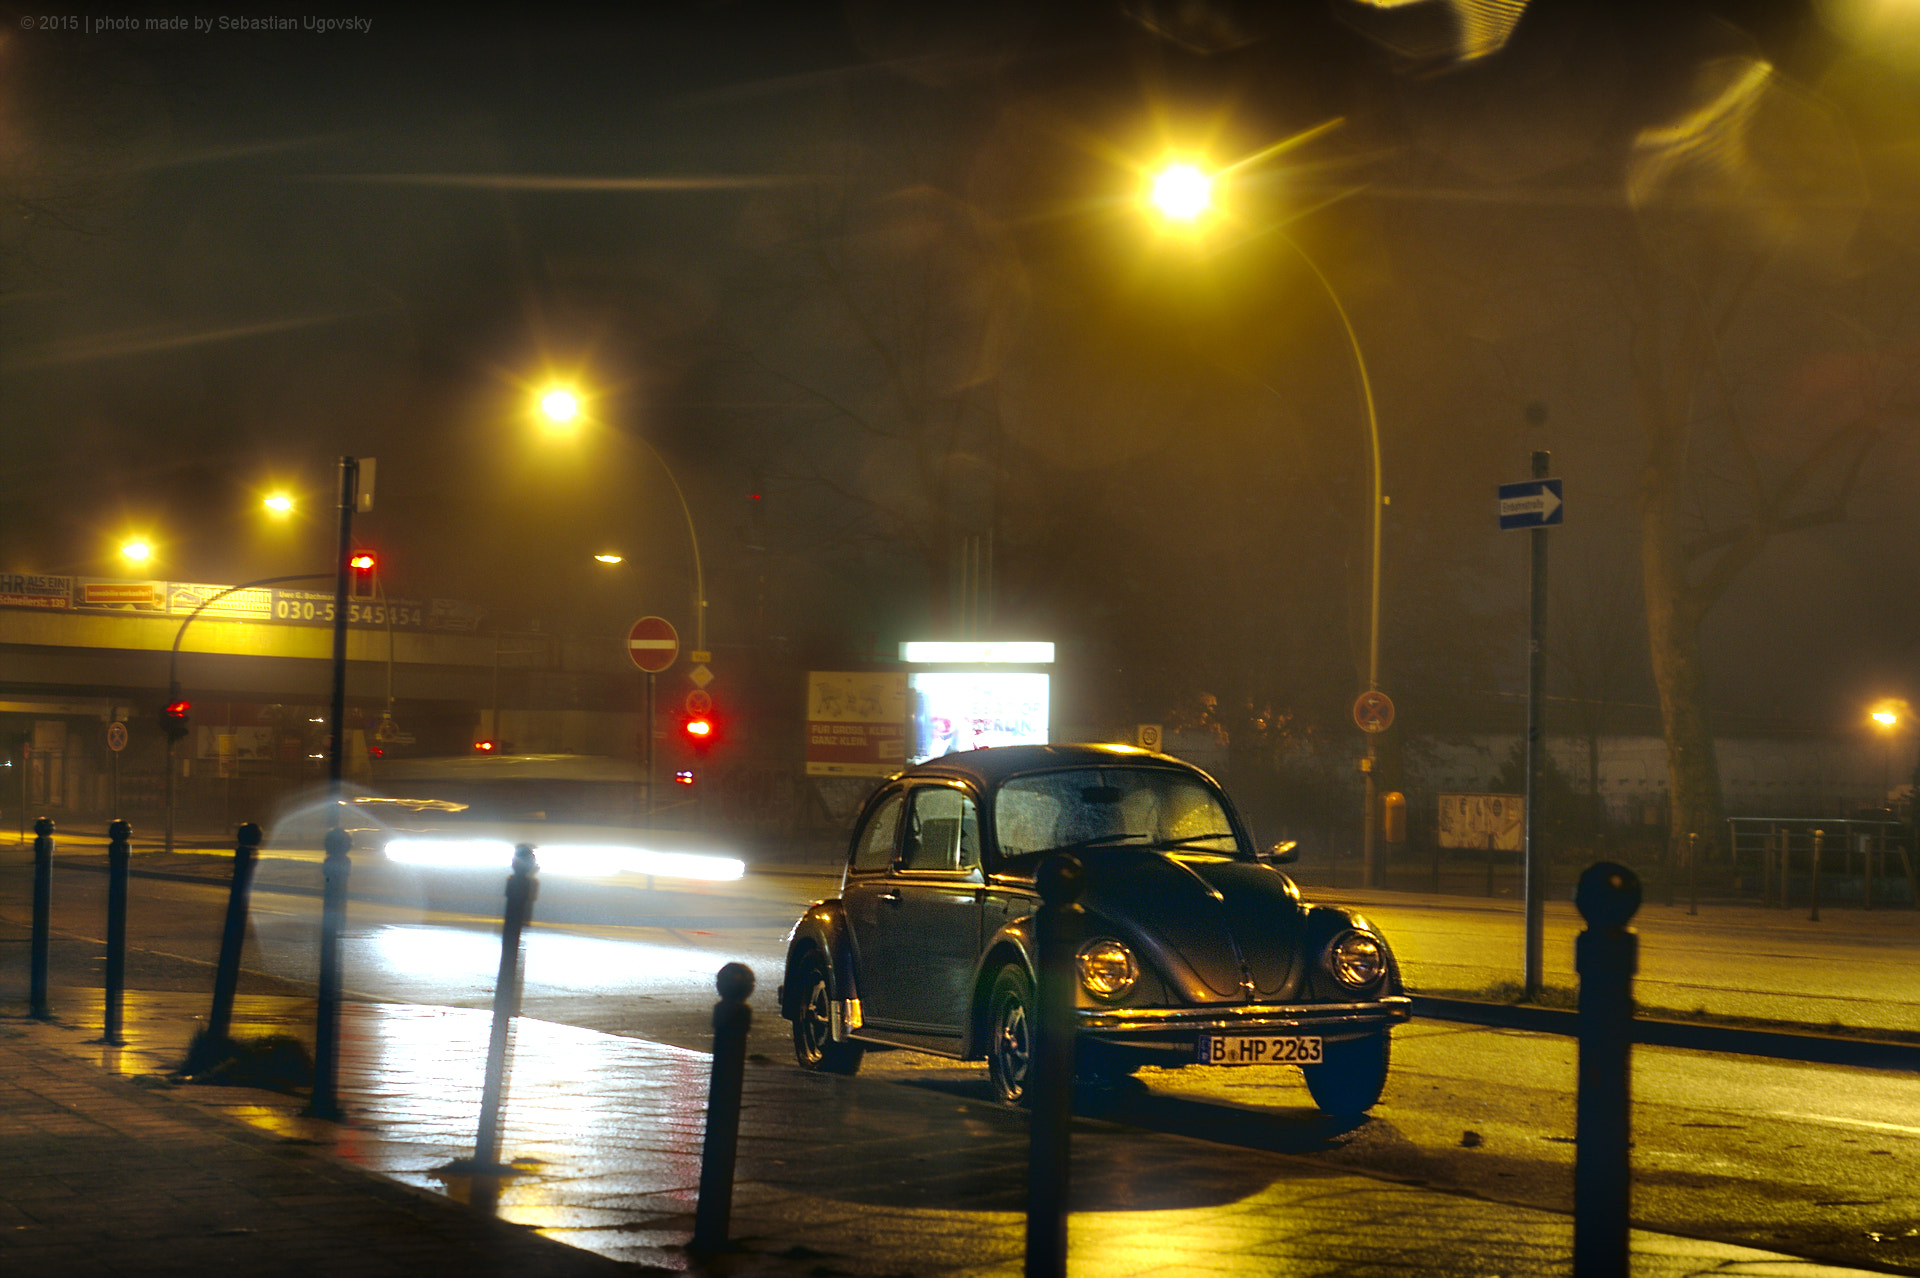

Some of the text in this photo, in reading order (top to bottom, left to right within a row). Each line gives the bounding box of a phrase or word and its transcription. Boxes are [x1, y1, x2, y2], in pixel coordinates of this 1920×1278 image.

[279, 591, 295, 599] Uwe
[296, 592, 304, 600] G.
[50, 598, 66, 607] 139
[277, 600, 422, 625] 030-5545454
[811, 735, 838, 745] GANZ
[1212, 1039, 1320, 1061] B HP 2263
